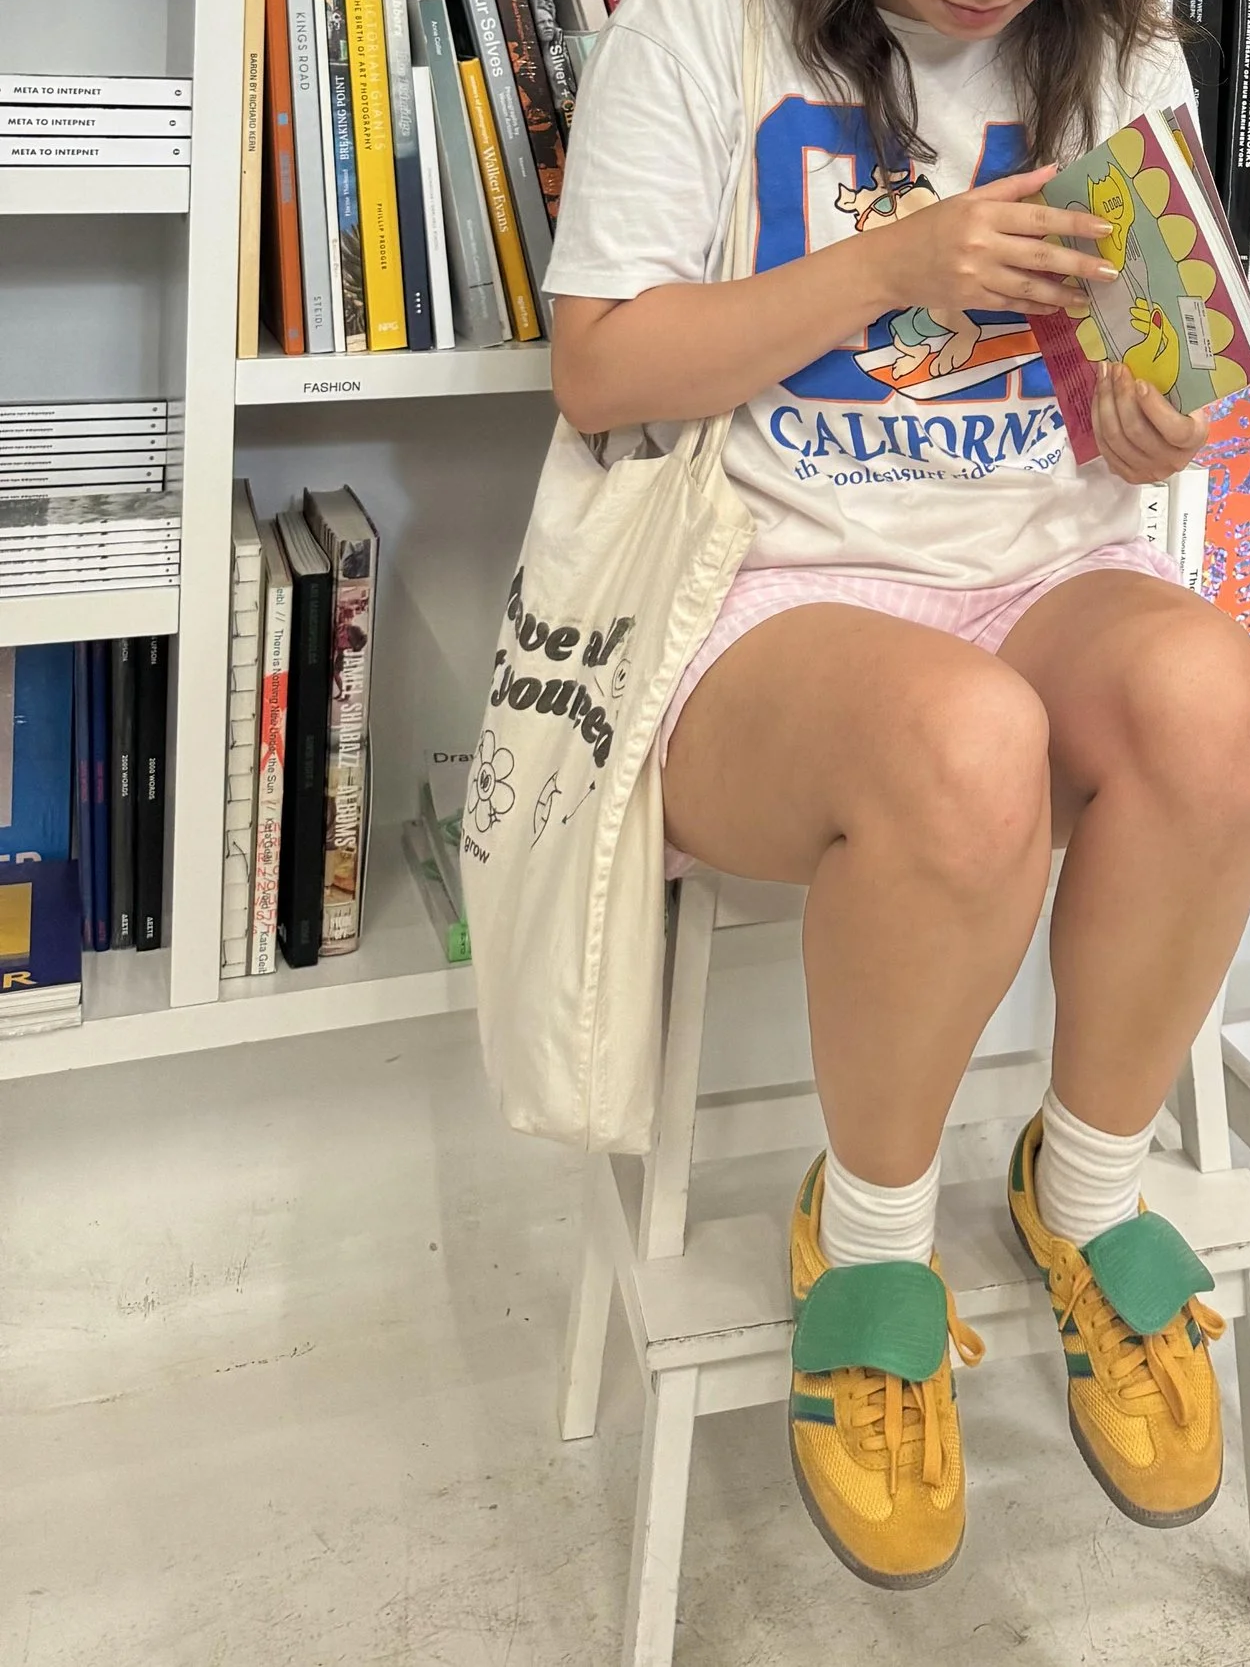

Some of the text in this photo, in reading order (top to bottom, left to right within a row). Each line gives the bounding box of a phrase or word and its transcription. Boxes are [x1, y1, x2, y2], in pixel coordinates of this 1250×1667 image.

[296, 11, 308, 52] KINGS
[355, 15, 365, 44] BIRTH
[483, 17, 503, 78] Selves
[299, 53, 311, 91] ROAD
[358, 61, 368, 79] ART
[548, 45, 566, 85] Silver
[248, 53, 258, 153] BARON BY RICHARD KERN
[335, 75, 346, 104] POINT
[337, 106, 350, 161] BREAKING
[360, 82, 373, 151] PHOTOGRAPHY
[370, 90, 387, 152] GIANTS
[482, 145, 510, 234] Walker Evans
[376, 202, 385, 232] PHILLIP
[313, 295, 324, 331] STEIDL
[303, 380, 361, 394] FASHION
[333, 648, 367, 848] JAMEL SHABAZZ ALBUMS
[120, 771, 129, 797] WORDS
[147, 757, 157, 800] 2000 WORDS
[257, 629, 285, 952] There Nothing Under the Sun Kata
